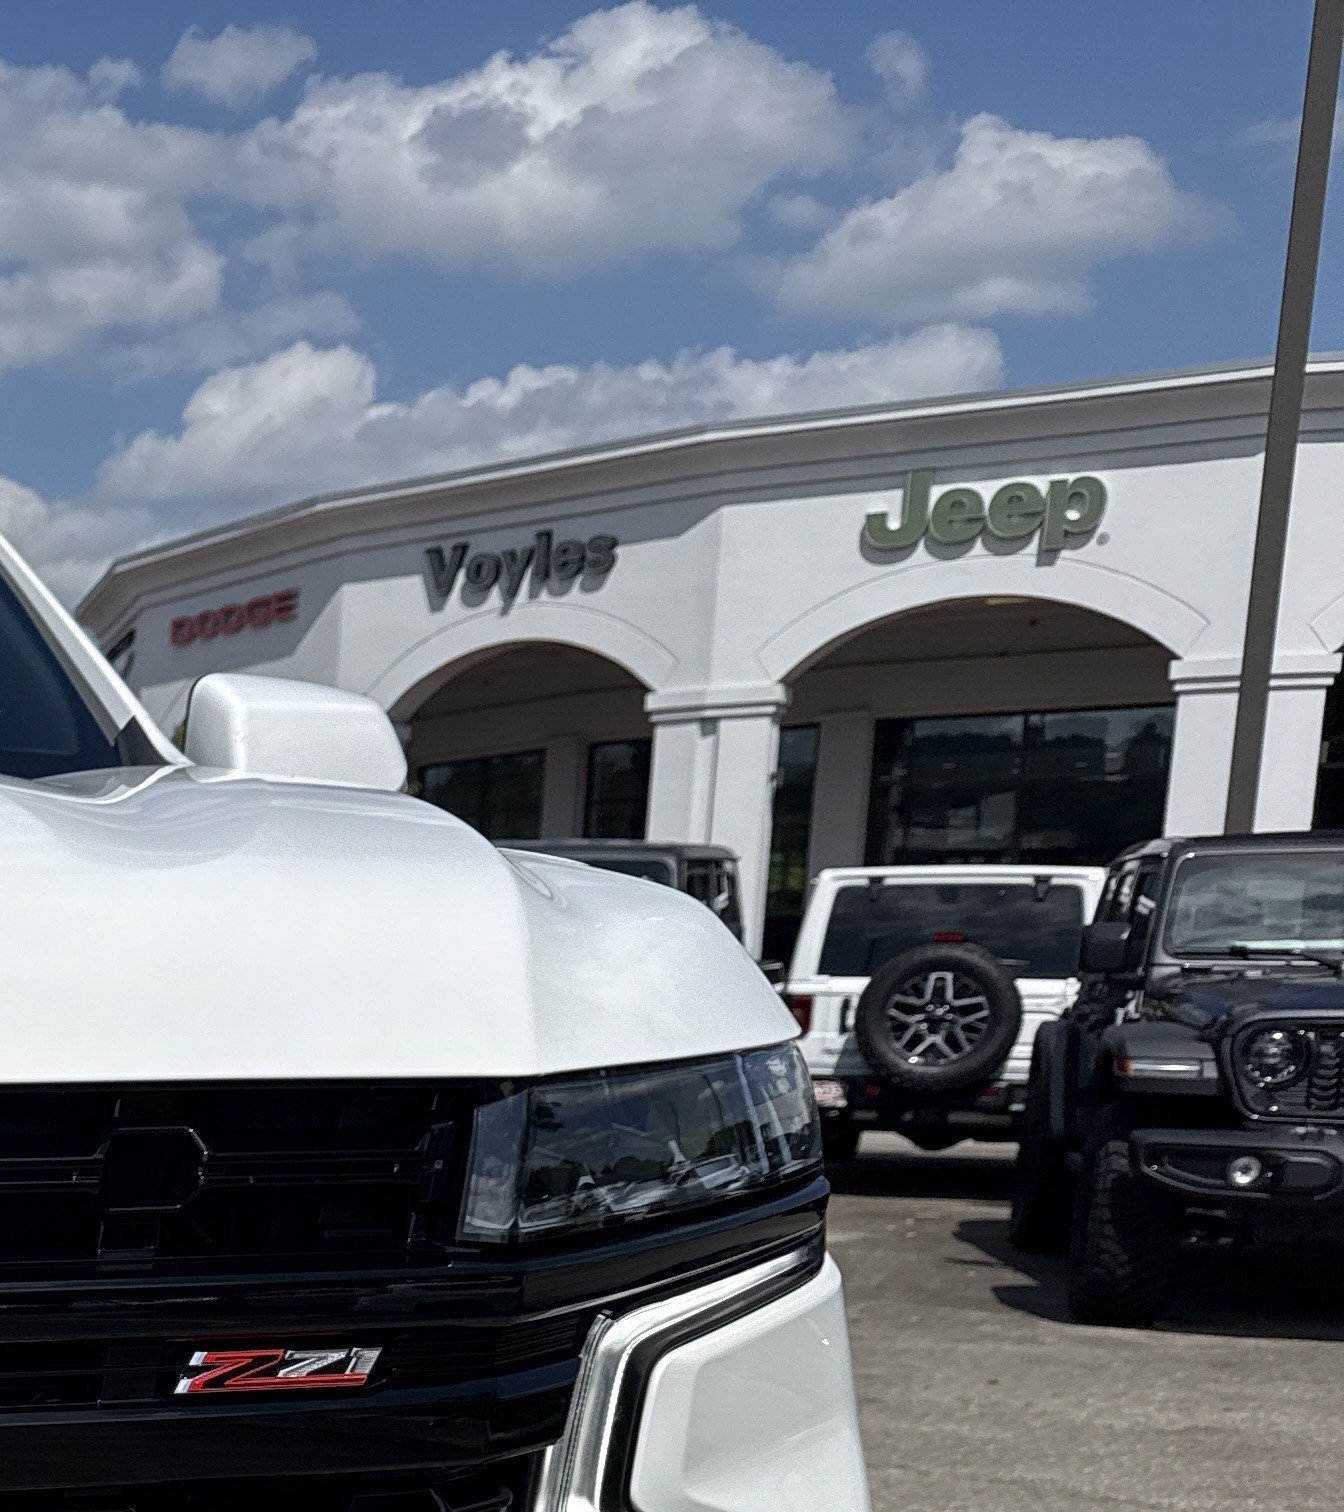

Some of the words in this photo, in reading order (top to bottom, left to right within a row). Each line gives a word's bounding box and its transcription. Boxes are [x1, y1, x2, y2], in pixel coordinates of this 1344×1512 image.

[864, 469, 1108, 555] Jeep
[423, 528, 620, 616] Voyles
[169, 587, 300, 648] DODGE
[173, 1346, 383, 1395] Z71
